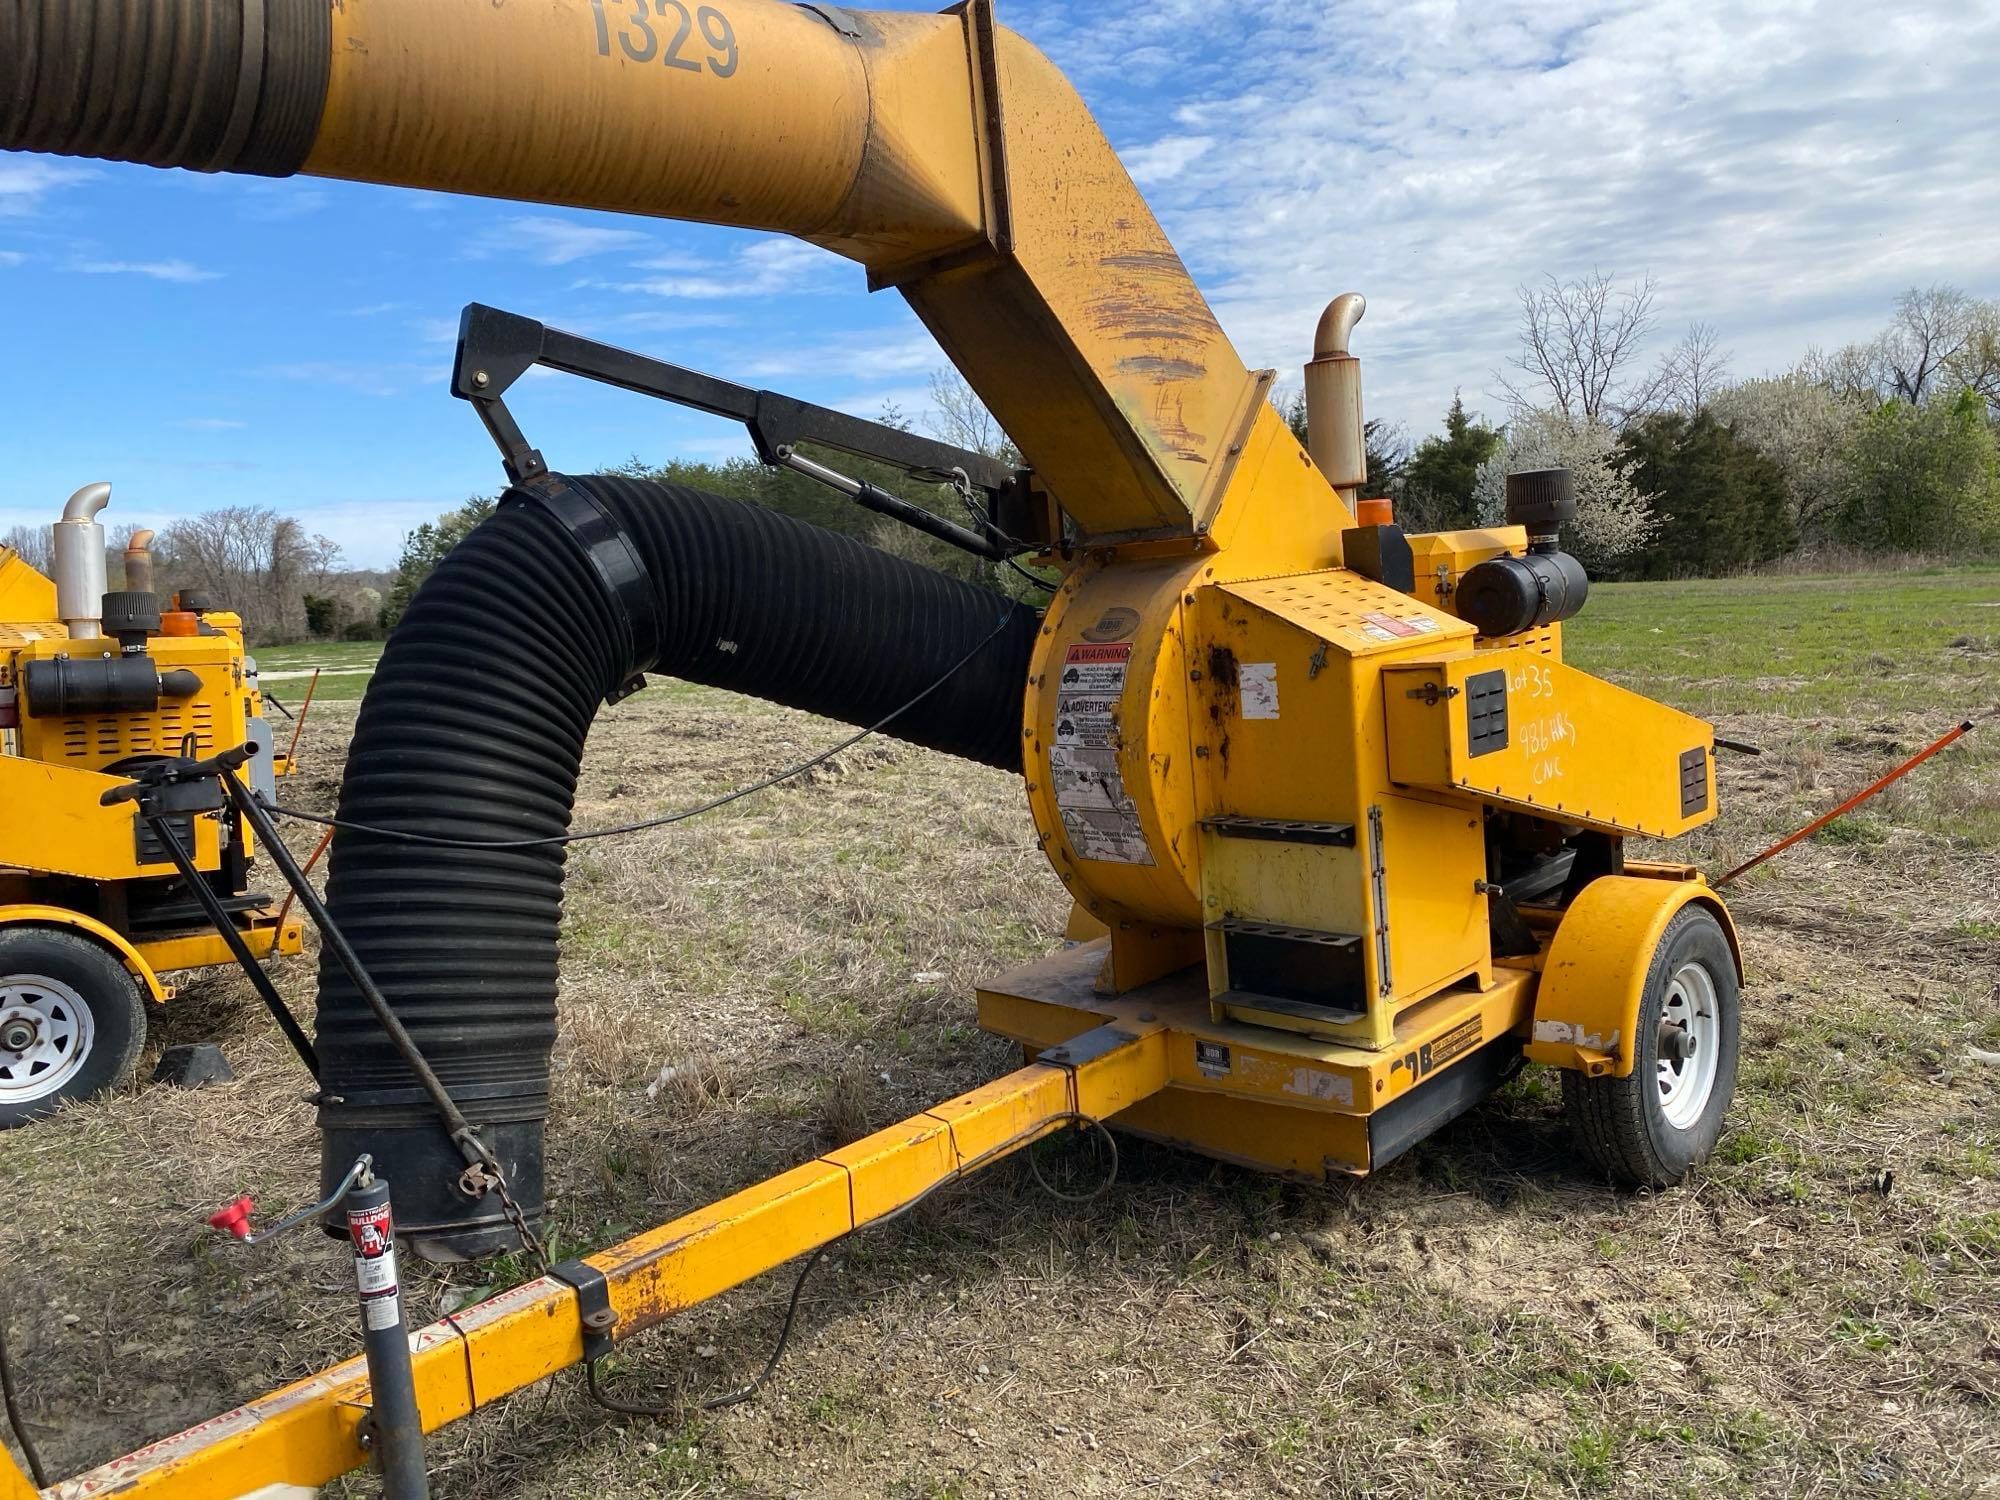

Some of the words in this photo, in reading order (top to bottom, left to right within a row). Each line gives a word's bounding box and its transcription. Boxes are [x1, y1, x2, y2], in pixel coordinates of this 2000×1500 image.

[591, 0, 738, 78] 1329
[1081, 647, 1129, 660] WARNING
[1529, 665, 1553, 698] 35
[351, 1211, 390, 1225] BULLDOG
